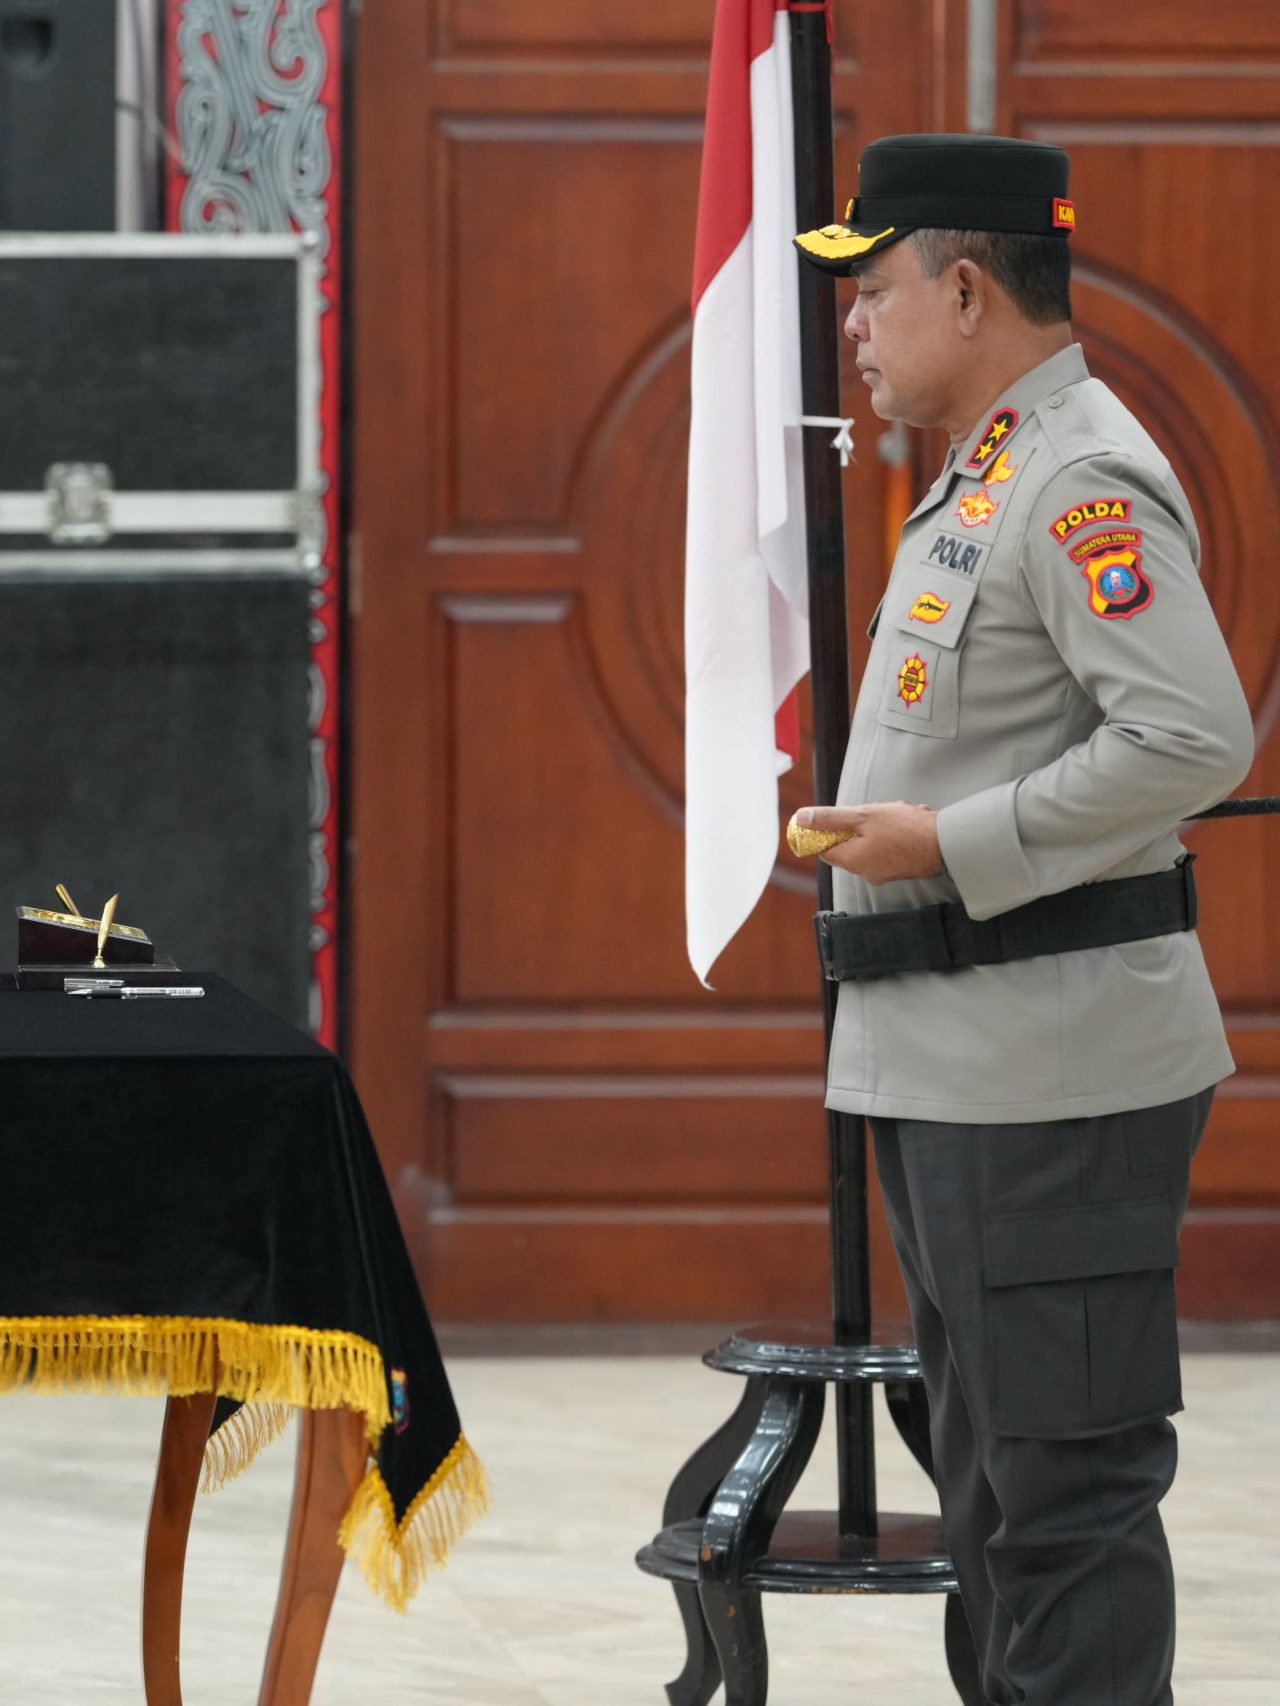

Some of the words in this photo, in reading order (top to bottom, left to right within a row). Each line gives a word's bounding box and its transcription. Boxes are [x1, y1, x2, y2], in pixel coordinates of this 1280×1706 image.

[1055, 502, 1125, 537] POLDA
[928, 535, 983, 576] POLRI
[1074, 534, 1111, 558] SUMATERA
[1111, 533, 1137, 542] UTARA
